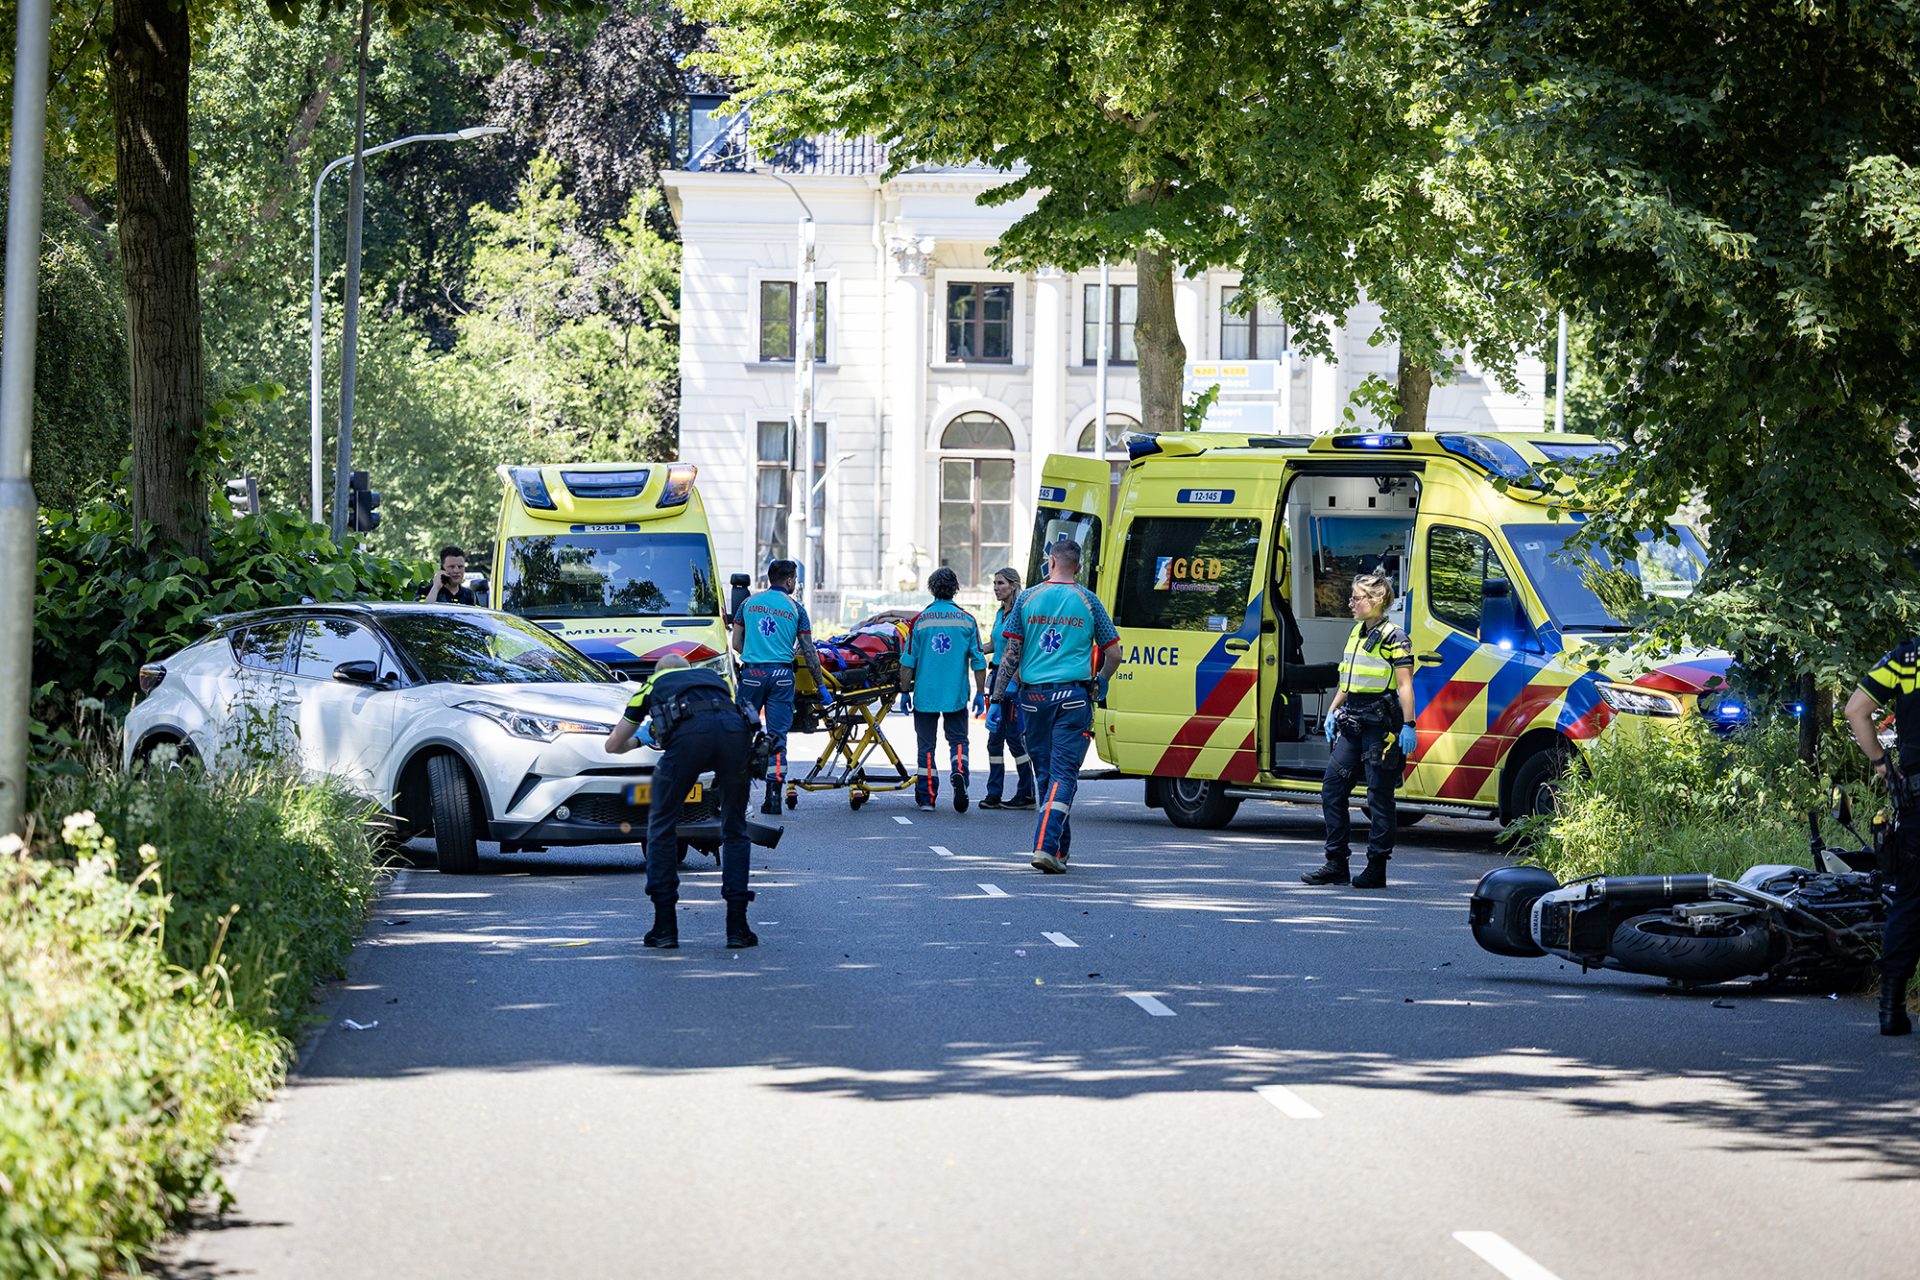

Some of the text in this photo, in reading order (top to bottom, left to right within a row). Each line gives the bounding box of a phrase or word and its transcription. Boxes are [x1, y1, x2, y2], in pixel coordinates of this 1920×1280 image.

[1194, 492, 1218, 501] 12-145
[591, 524, 621, 532] 12-143
[1173, 558, 1221, 579] GGD
[748, 604, 793, 621] AMBULANCE
[920, 611, 965, 621] AMBULANCE
[1027, 615, 1084, 628] AMBULANCE
[554, 627, 679, 637] AMBULANCE
[1119, 645, 1179, 667] LANCE
[1115, 671, 1133, 681] land
